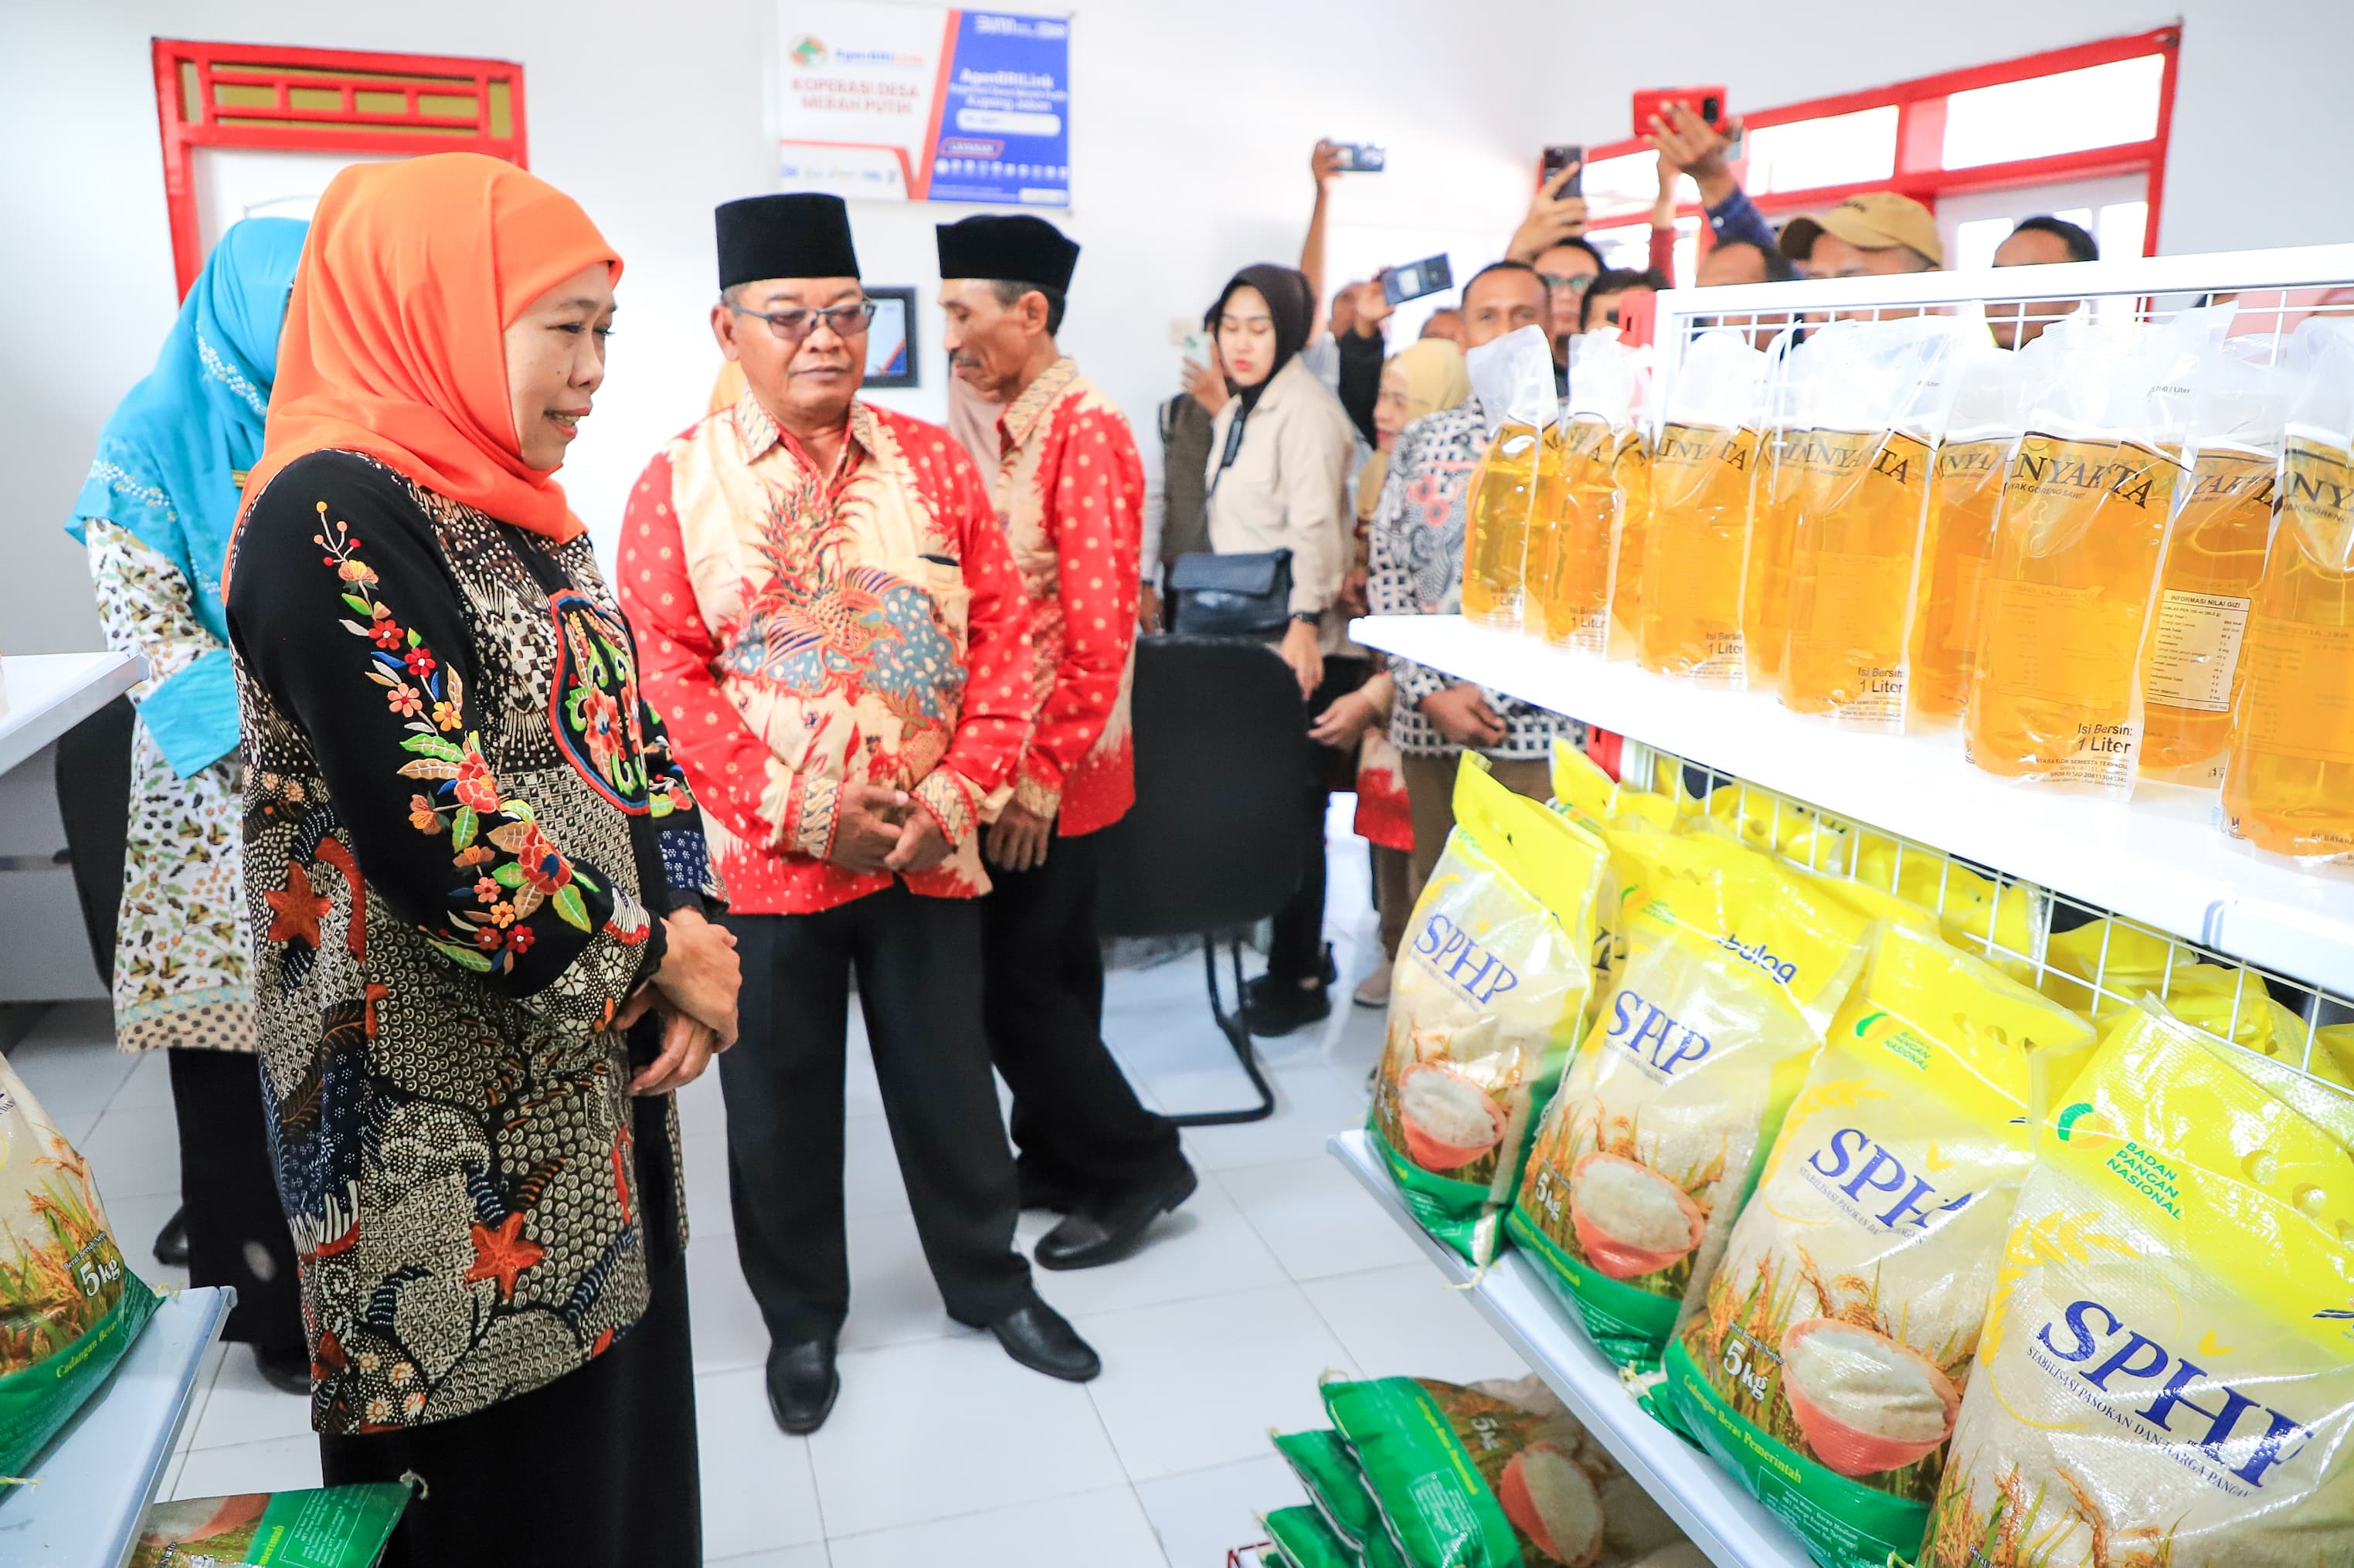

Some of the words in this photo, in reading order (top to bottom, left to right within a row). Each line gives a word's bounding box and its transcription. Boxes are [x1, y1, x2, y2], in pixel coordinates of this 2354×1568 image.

[878, 82, 919, 97] DESA
[2171, 595, 2206, 605] INFORMASI
[1707, 643, 1714, 654] 1
[1858, 667, 1870, 677] Isi
[1860, 680, 1866, 692] 1
[1872, 680, 1904, 694] Liter
[2077, 723, 2091, 734] Isi
[2078, 737, 2087, 751] 1
[2090, 736, 2132, 754] Liter
[1414, 914, 1517, 1004] SPHP
[2115, 1149, 2179, 1199] PANGAN
[2125, 1142, 2178, 1181] BADAN
[1535, 1172, 1550, 1202] 5
[1545, 1187, 1562, 1222] kg
[2106, 1158, 2180, 1220] NASIONAL
[63, 1256, 79, 1271] Berat
[80, 1261, 100, 1298] 5
[98, 1255, 121, 1284] kg
[56, 1339, 97, 1379] Cadangan
[1723, 1339, 1747, 1376] 5
[1742, 1362, 1768, 1402] kg
[2027, 1346, 2079, 1392] STABILISASI
[2079, 1386, 2133, 1428] PASOKAN
[2134, 1424, 2162, 1445] DAN
[1744, 1431, 1802, 1484] Pemerintah
